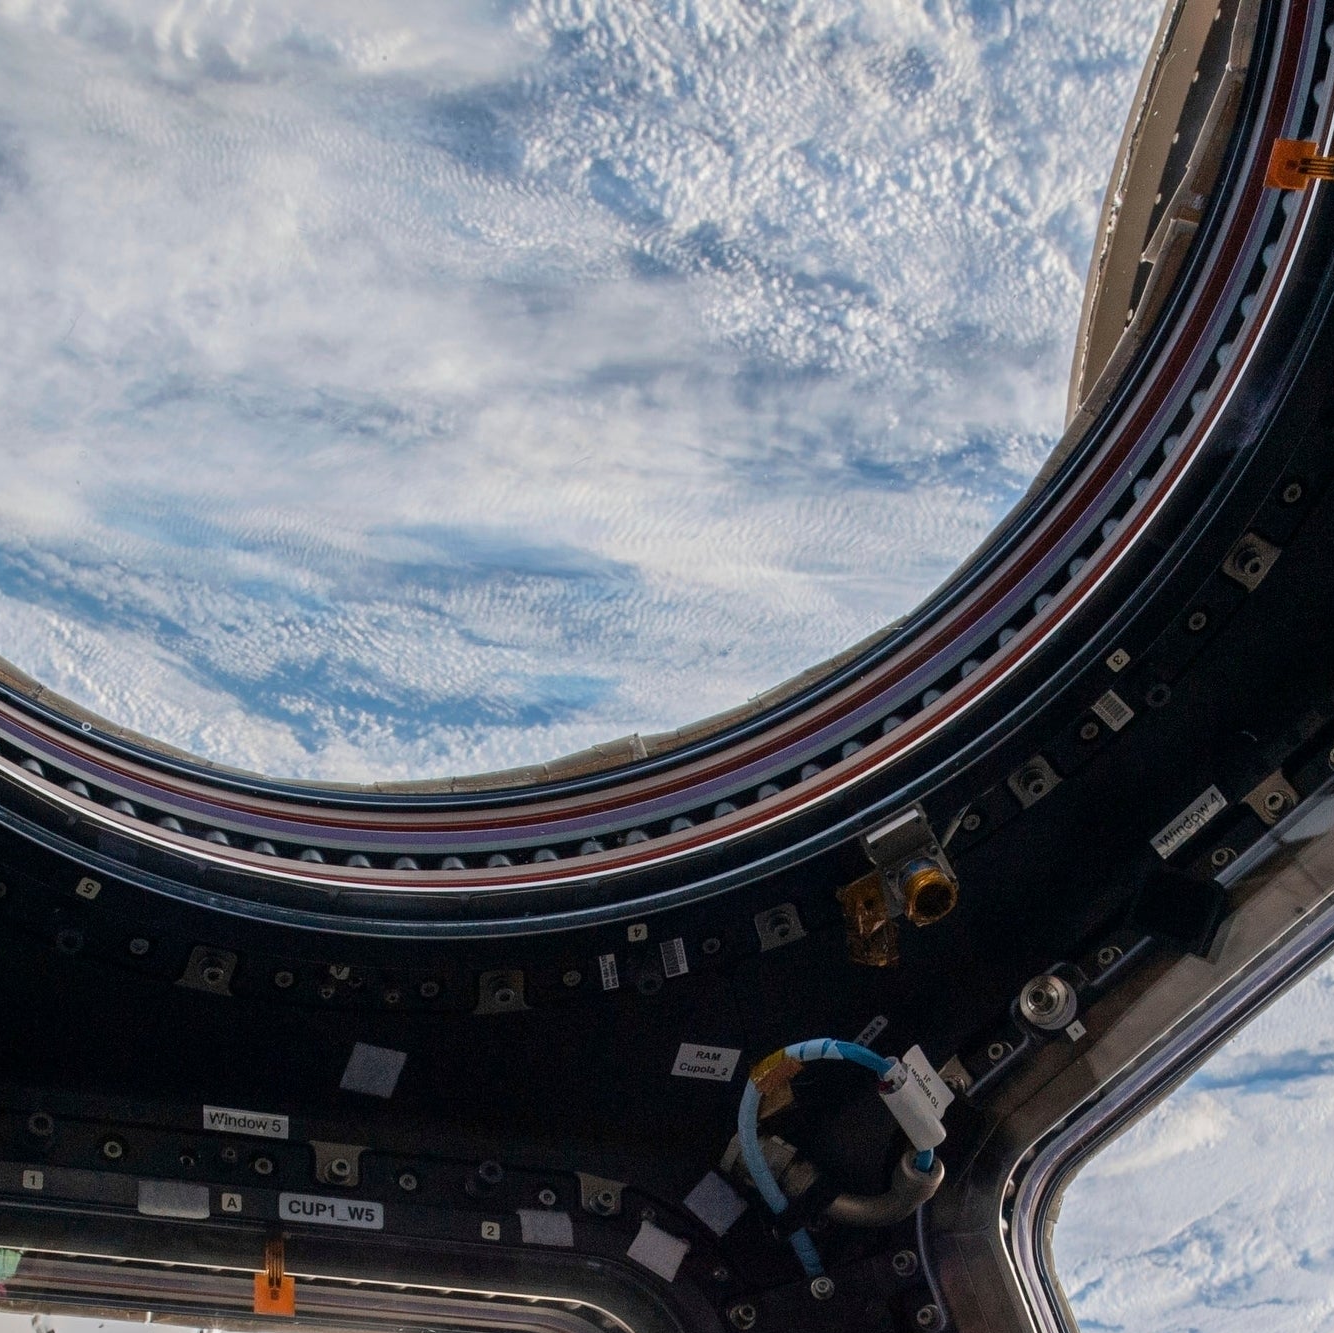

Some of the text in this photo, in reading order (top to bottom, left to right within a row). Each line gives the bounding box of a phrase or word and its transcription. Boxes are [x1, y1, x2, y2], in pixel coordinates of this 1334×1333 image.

[1158, 803, 1208, 847] Window
[696, 1050, 721, 1061] RAM
[679, 1062, 729, 1077] Cupola_2
[930, 1095, 940, 1108] TO
[209, 1111, 282, 1133] Window 5
[226, 1197, 238, 1209] A
[288, 1200, 375, 1222] CUP1_W5
